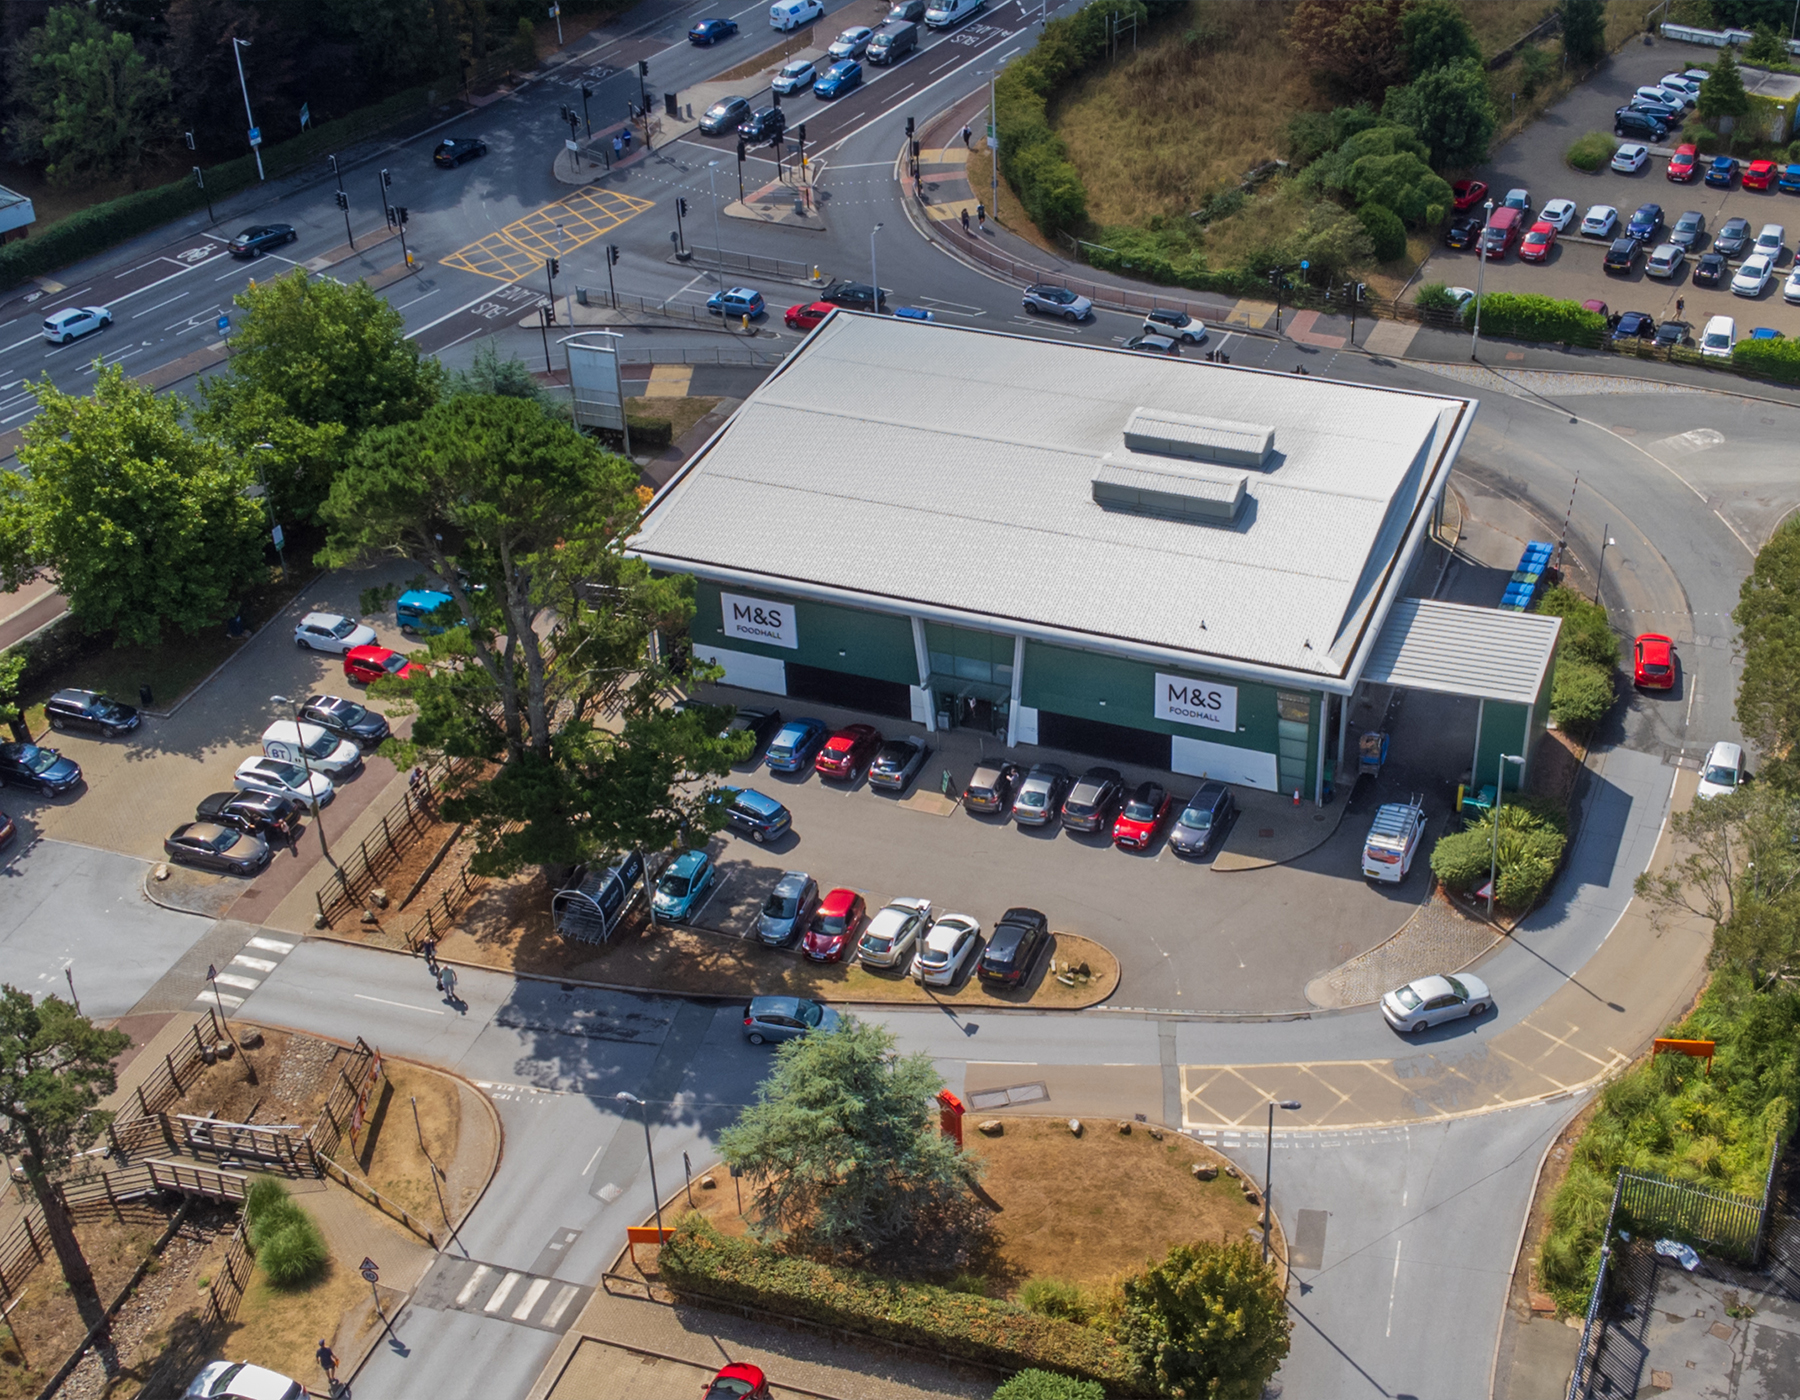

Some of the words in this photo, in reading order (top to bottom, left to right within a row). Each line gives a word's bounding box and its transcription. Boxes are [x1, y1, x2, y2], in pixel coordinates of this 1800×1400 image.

[496, 285, 540, 305] LANE
[471, 302, 509, 319] BUS
[733, 603, 782, 628] M&S
[736, 625, 782, 640] FOODHALL
[1168, 683, 1222, 710] M&S
[1169, 706, 1220, 723] FOODHALL
[271, 748, 286, 759] BT
